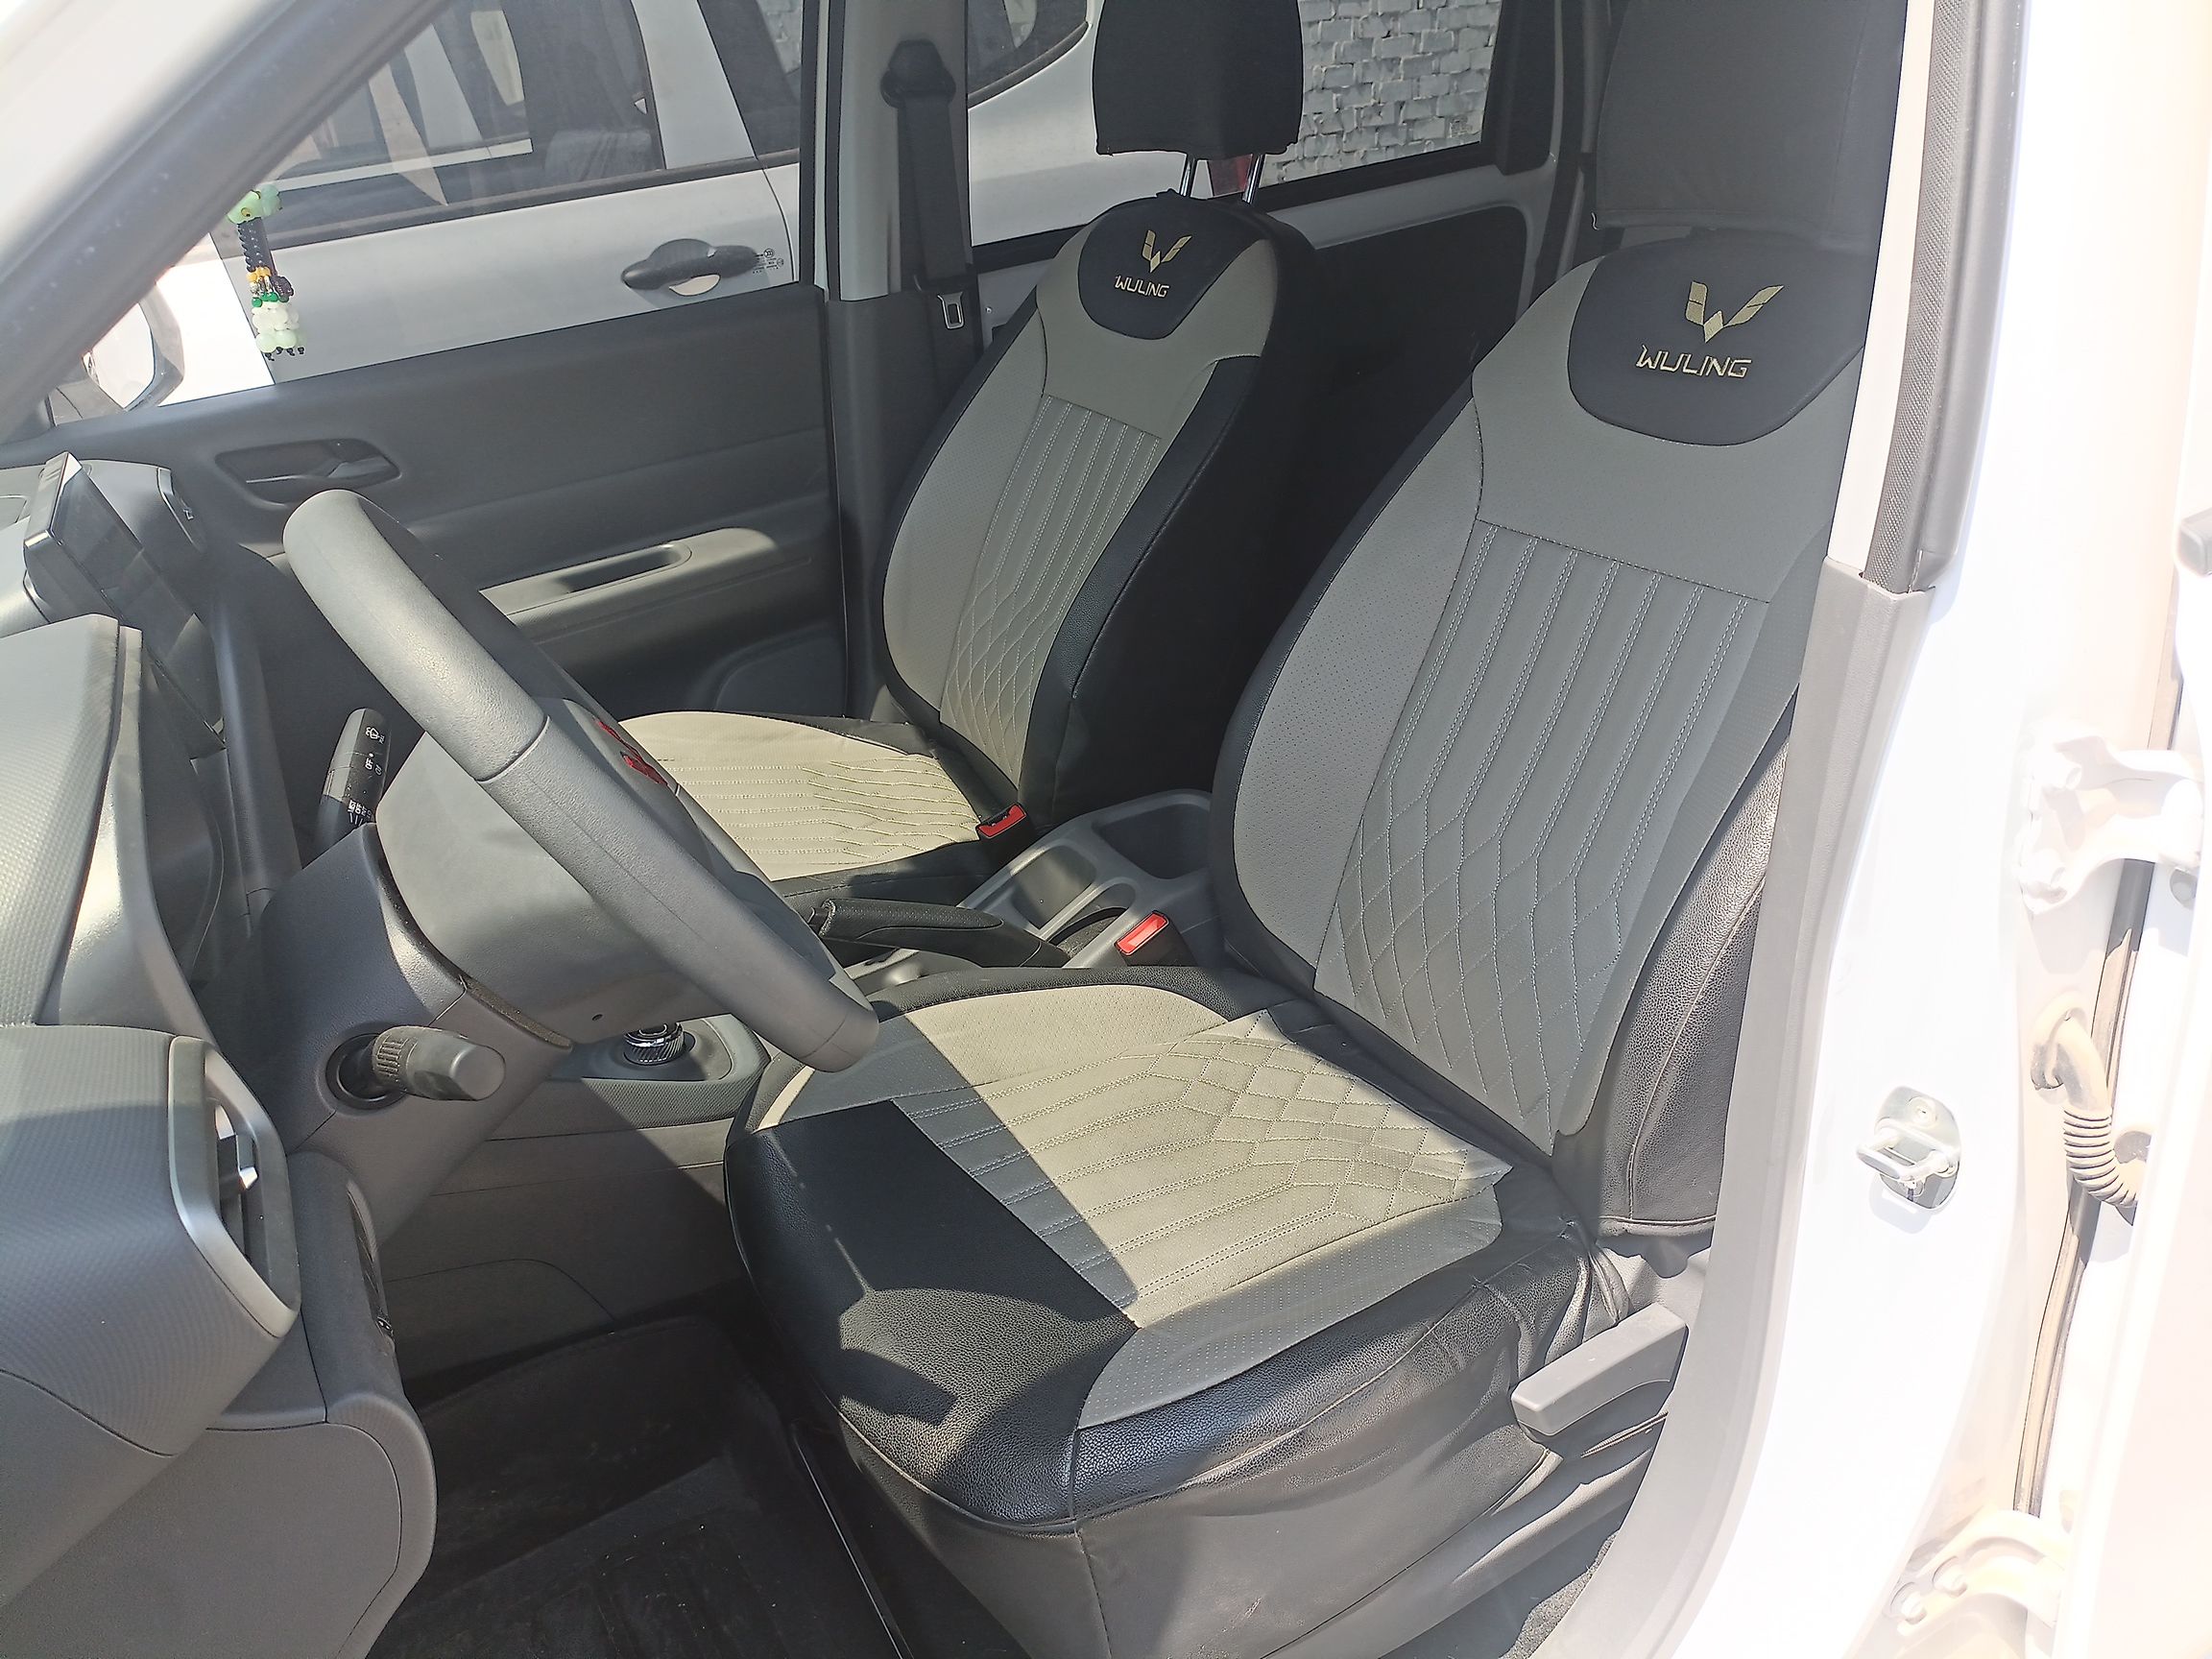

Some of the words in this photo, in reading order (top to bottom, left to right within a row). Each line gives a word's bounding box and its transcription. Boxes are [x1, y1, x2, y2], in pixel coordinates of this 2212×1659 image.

[1115, 275, 1170, 298] WULING
[1635, 344, 1752, 379] WULING
[365, 757, 373, 770] OFF
